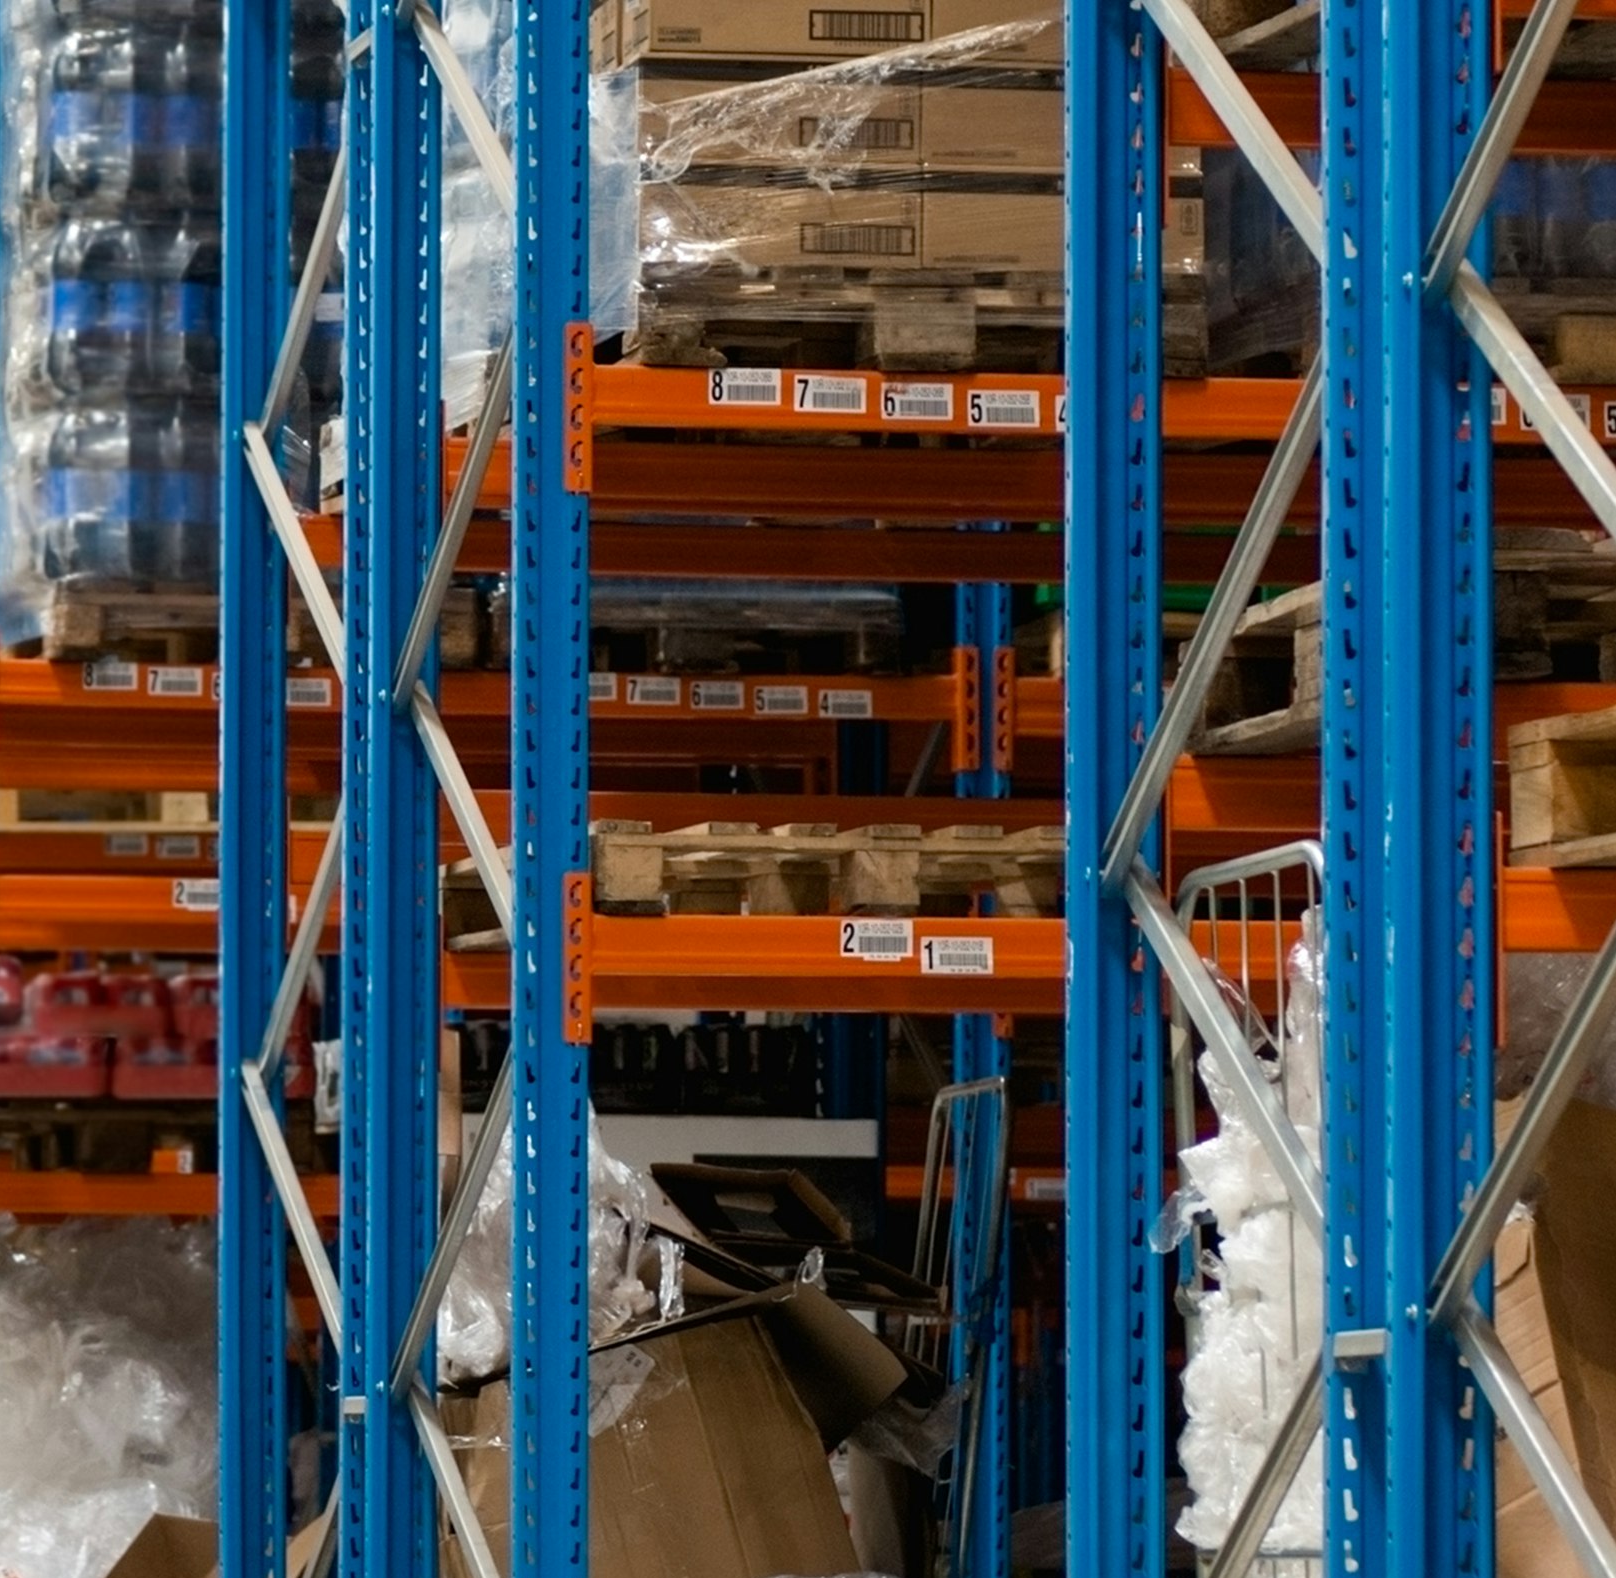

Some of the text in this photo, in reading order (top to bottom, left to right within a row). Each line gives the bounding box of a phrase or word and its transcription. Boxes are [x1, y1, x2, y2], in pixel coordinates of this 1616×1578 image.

[711, 370, 723, 402] 8
[797, 378, 809, 409] 7
[883, 388, 896, 417] 6
[970, 393, 983, 424] 5
[83, 663, 94, 687] 8
[149, 669, 159, 692] 7
[628, 679, 637, 701] 7
[692, 684, 702, 706] 6
[755, 689, 766, 711] 5
[819, 692, 830, 715] 4
[174, 882, 184, 904] 2
[843, 923, 855, 953] 2
[924, 941, 934, 969] 1
